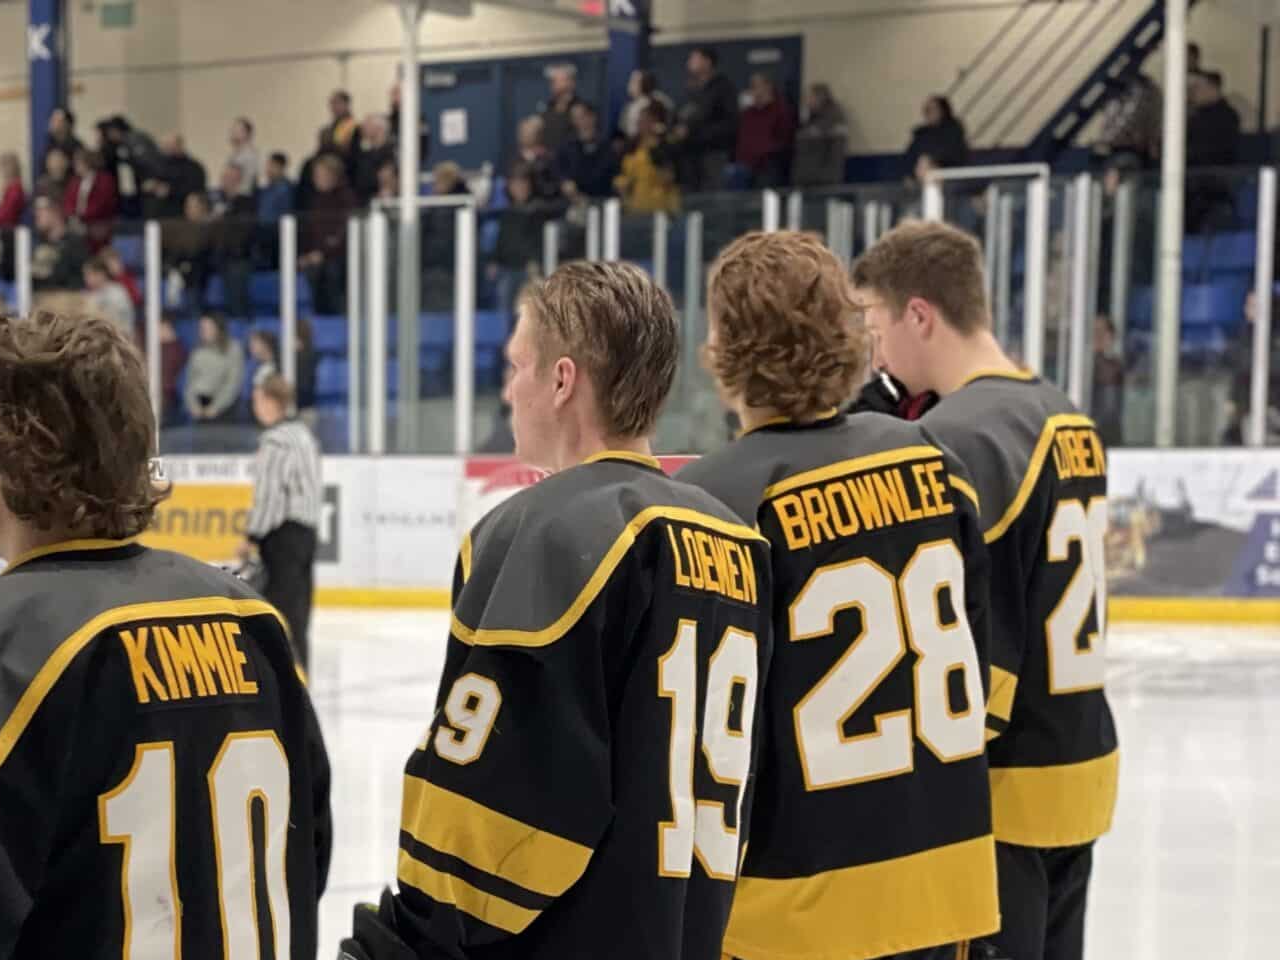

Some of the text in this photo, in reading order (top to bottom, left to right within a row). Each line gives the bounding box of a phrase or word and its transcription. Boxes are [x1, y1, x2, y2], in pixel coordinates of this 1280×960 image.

[27, 23, 52, 60] K
[773, 461, 953, 550] BROWNLEE
[666, 524, 757, 605] LOEWEN
[120, 622, 259, 703] KIMMIE
[789, 538, 985, 792] 28
[658, 618, 758, 882] 19
